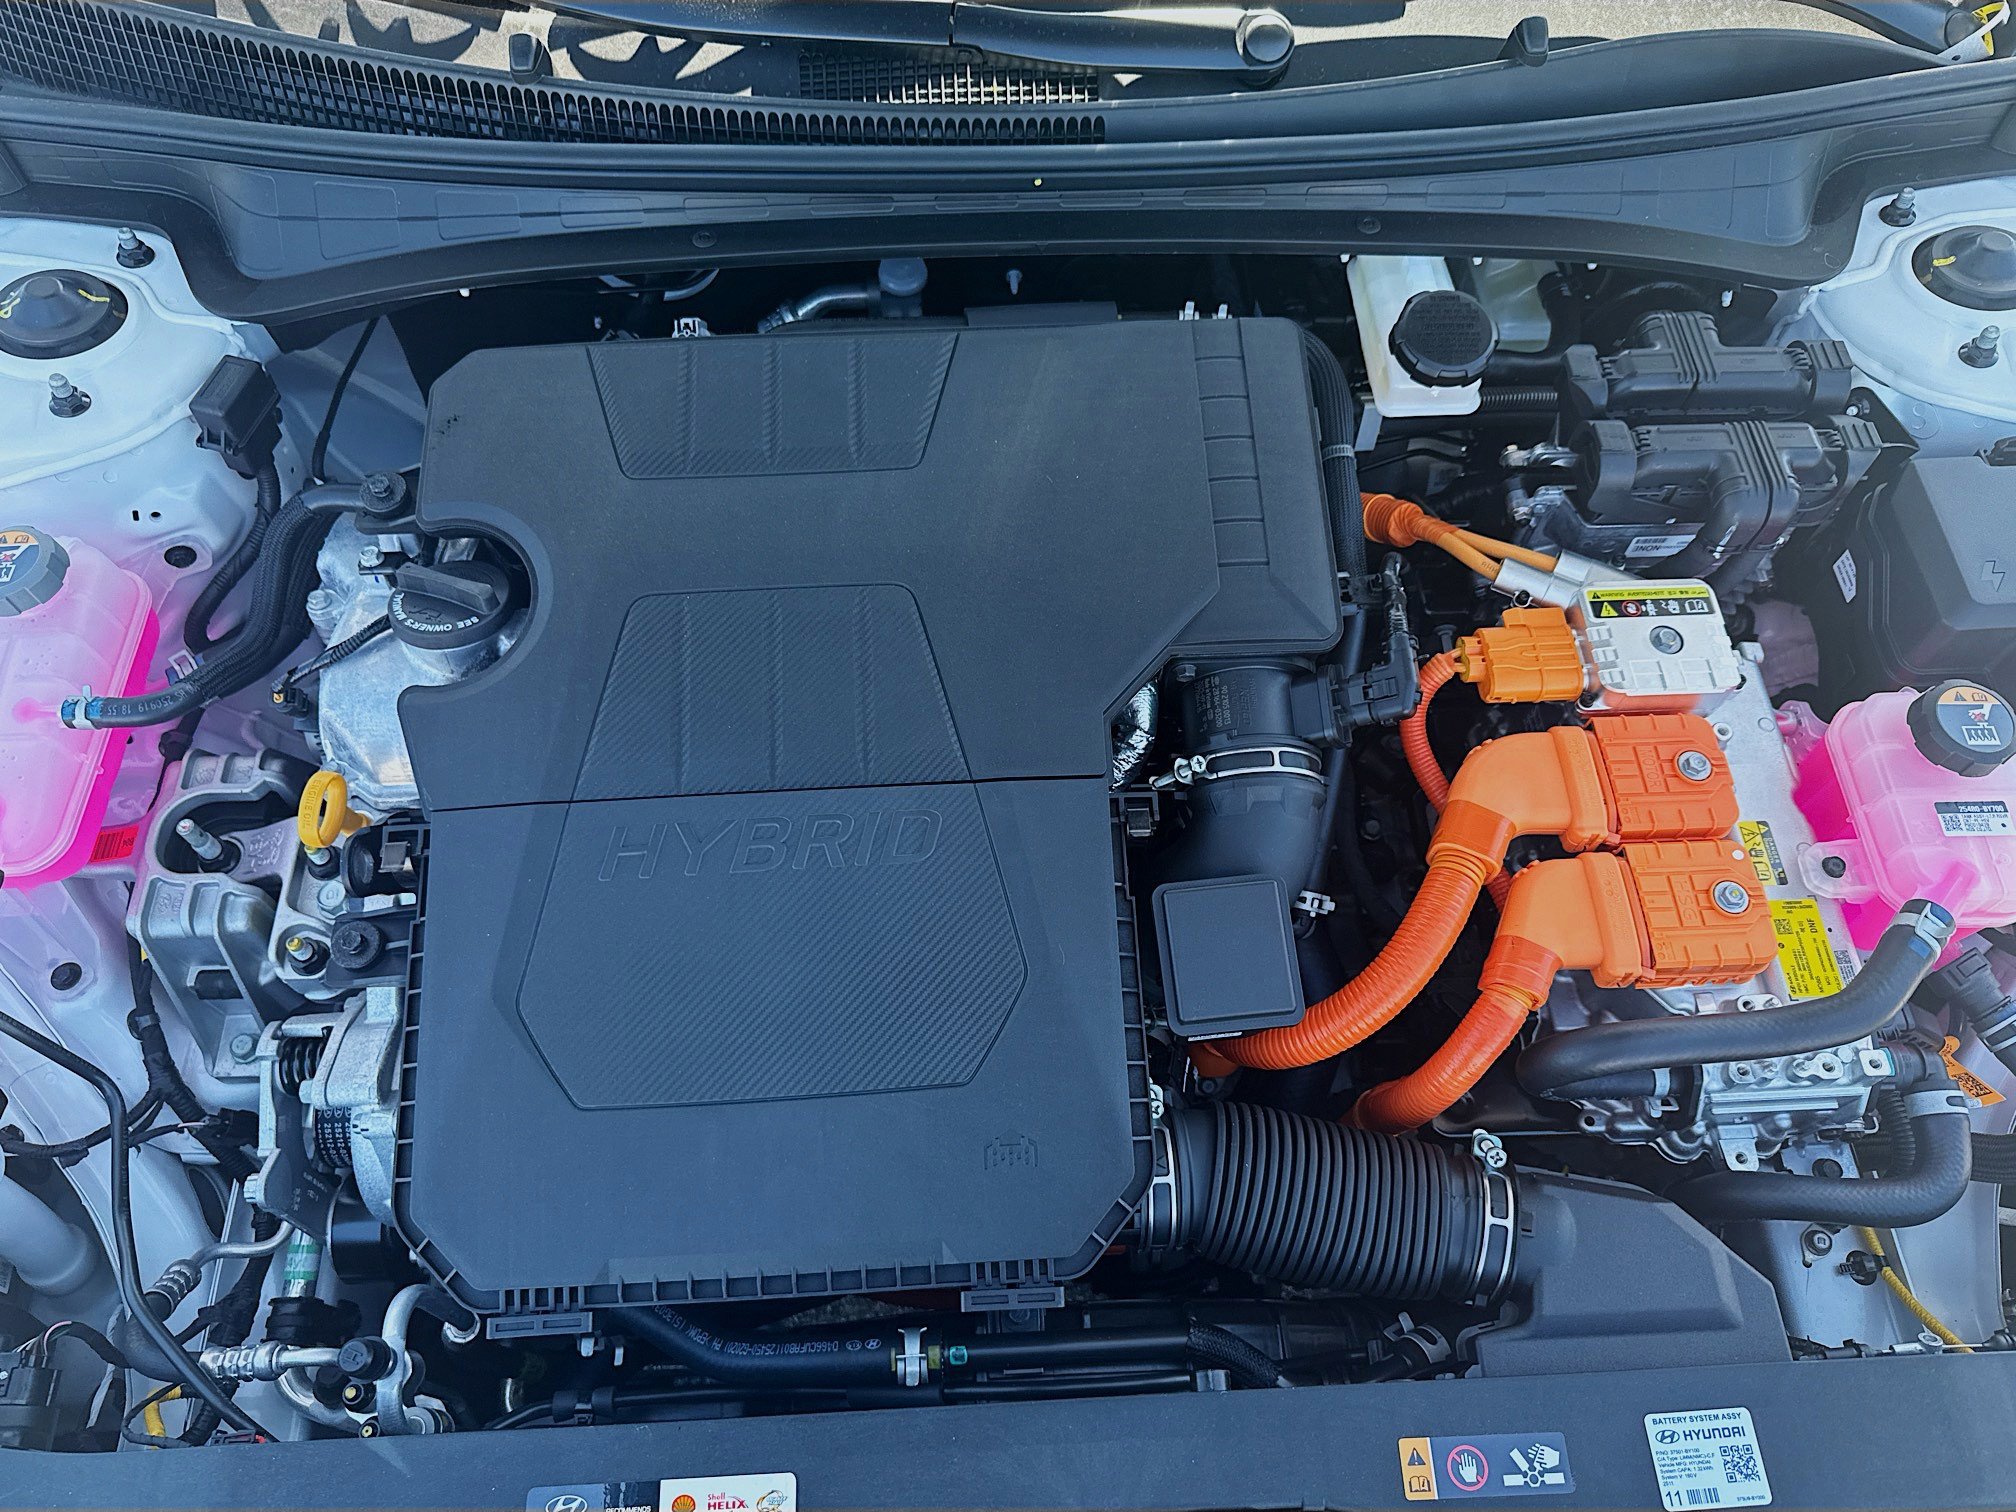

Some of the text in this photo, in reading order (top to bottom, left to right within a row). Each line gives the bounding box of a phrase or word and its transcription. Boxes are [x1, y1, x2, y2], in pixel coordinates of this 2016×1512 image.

[404, 618, 453, 632] OWNER'S
[456, 616, 480, 630] SEE
[1644, 746, 1663, 791] MOTOR
[598, 809, 943, 882] HYBRID
[1680, 878, 1699, 923] HSG
[1652, 1412, 1741, 1426] BATTERY SYSTEM ASSY
[1683, 1426, 1746, 1441] HYUNDAI
[707, 1492, 726, 1502] Shell
[1666, 1490, 1683, 1507] 11
[707, 1499, 747, 1512] HELIX
